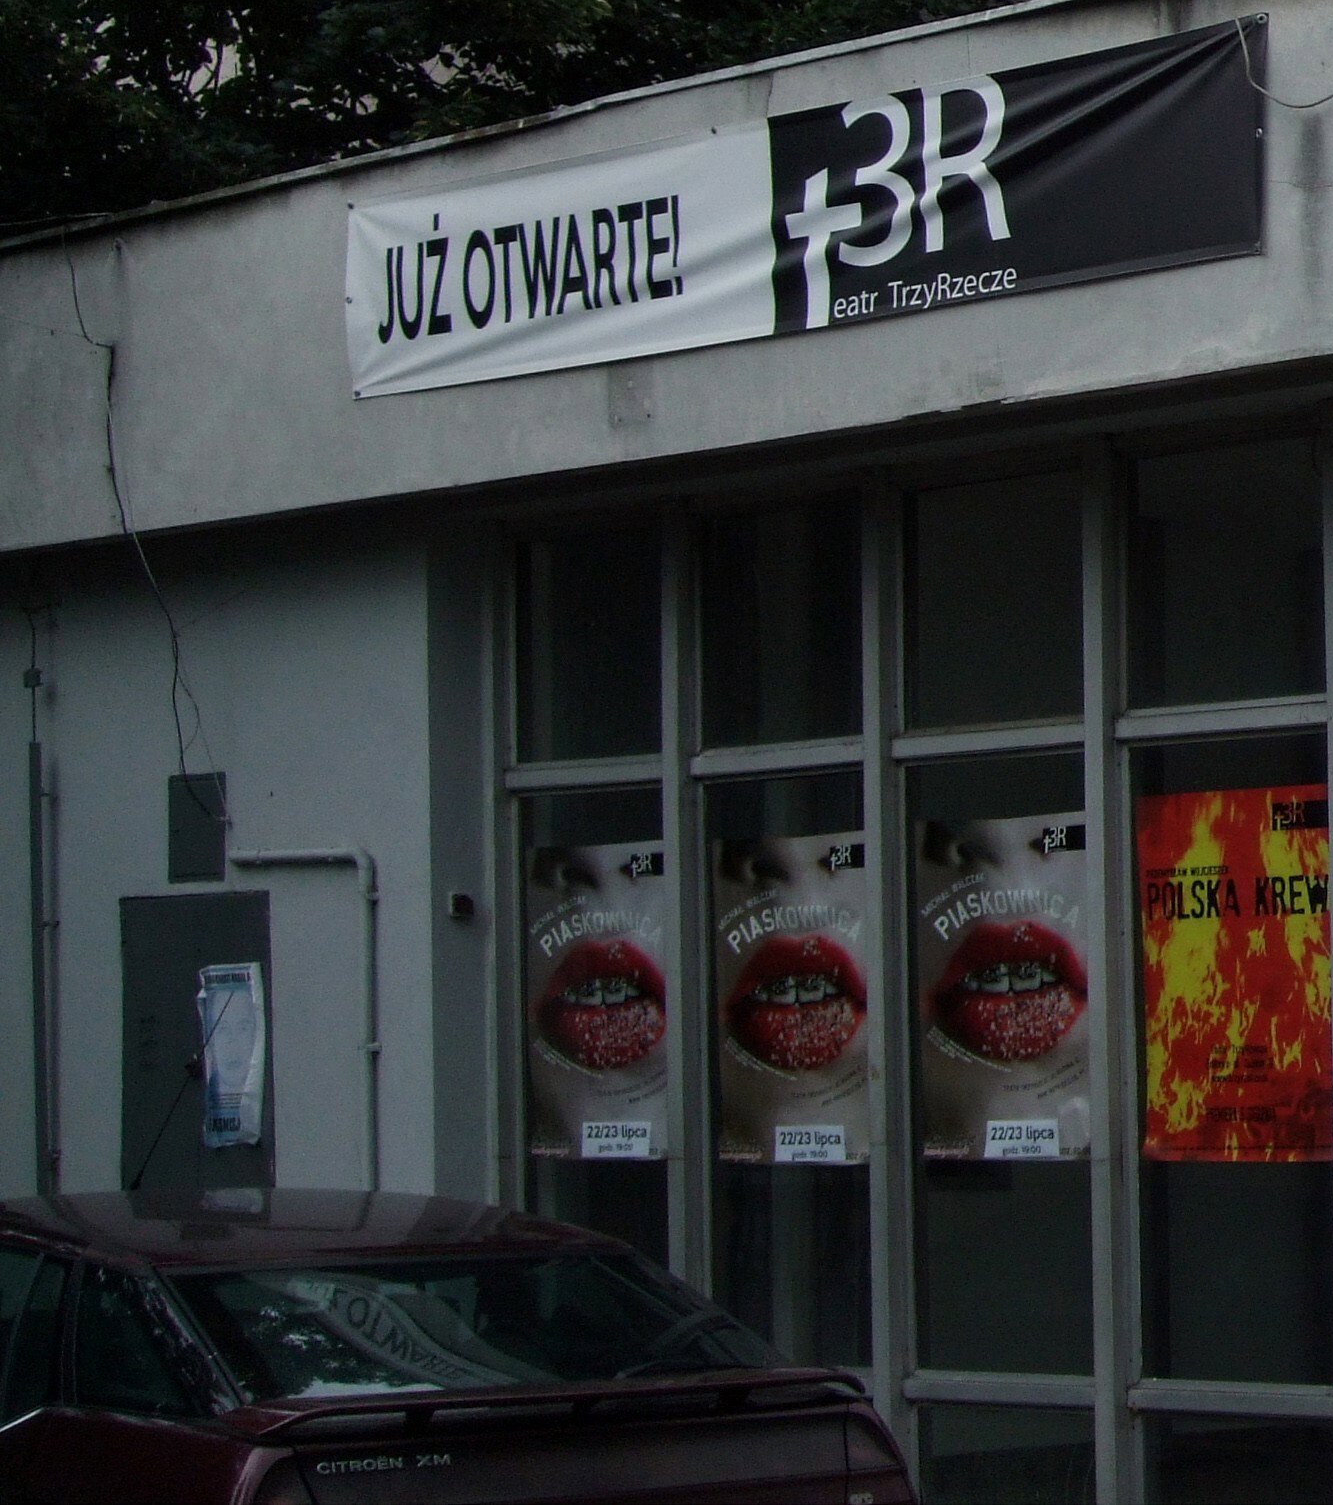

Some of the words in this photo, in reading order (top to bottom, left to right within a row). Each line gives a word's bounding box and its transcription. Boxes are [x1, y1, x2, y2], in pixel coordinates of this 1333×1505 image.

[377, 211, 453, 345] JUŻ
[462, 194, 685, 331] OTWARTE!
[888, 266, 1018, 311] TrzyRzecze
[933, 888, 1080, 941] PIASKOWNICA
[1147, 879, 1241, 921] POLSKA
[1255, 874, 1328, 917] KREW
[540, 910, 663, 958] PIASKOWNICA
[727, 904, 861, 955] PIASKOWNICA
[586, 1125, 618, 1139] 22/23
[620, 1124, 647, 1141] lipca
[780, 1131, 811, 1145] 22/23
[814, 1130, 842, 1148] lipca
[990, 1126, 1022, 1140] 22/23
[1026, 1125, 1055, 1142] lipca
[1021, 1144, 1041, 1155] 19:00
[317, 1455, 404, 1475] CITROËN
[416, 1453, 451, 1468] XM
